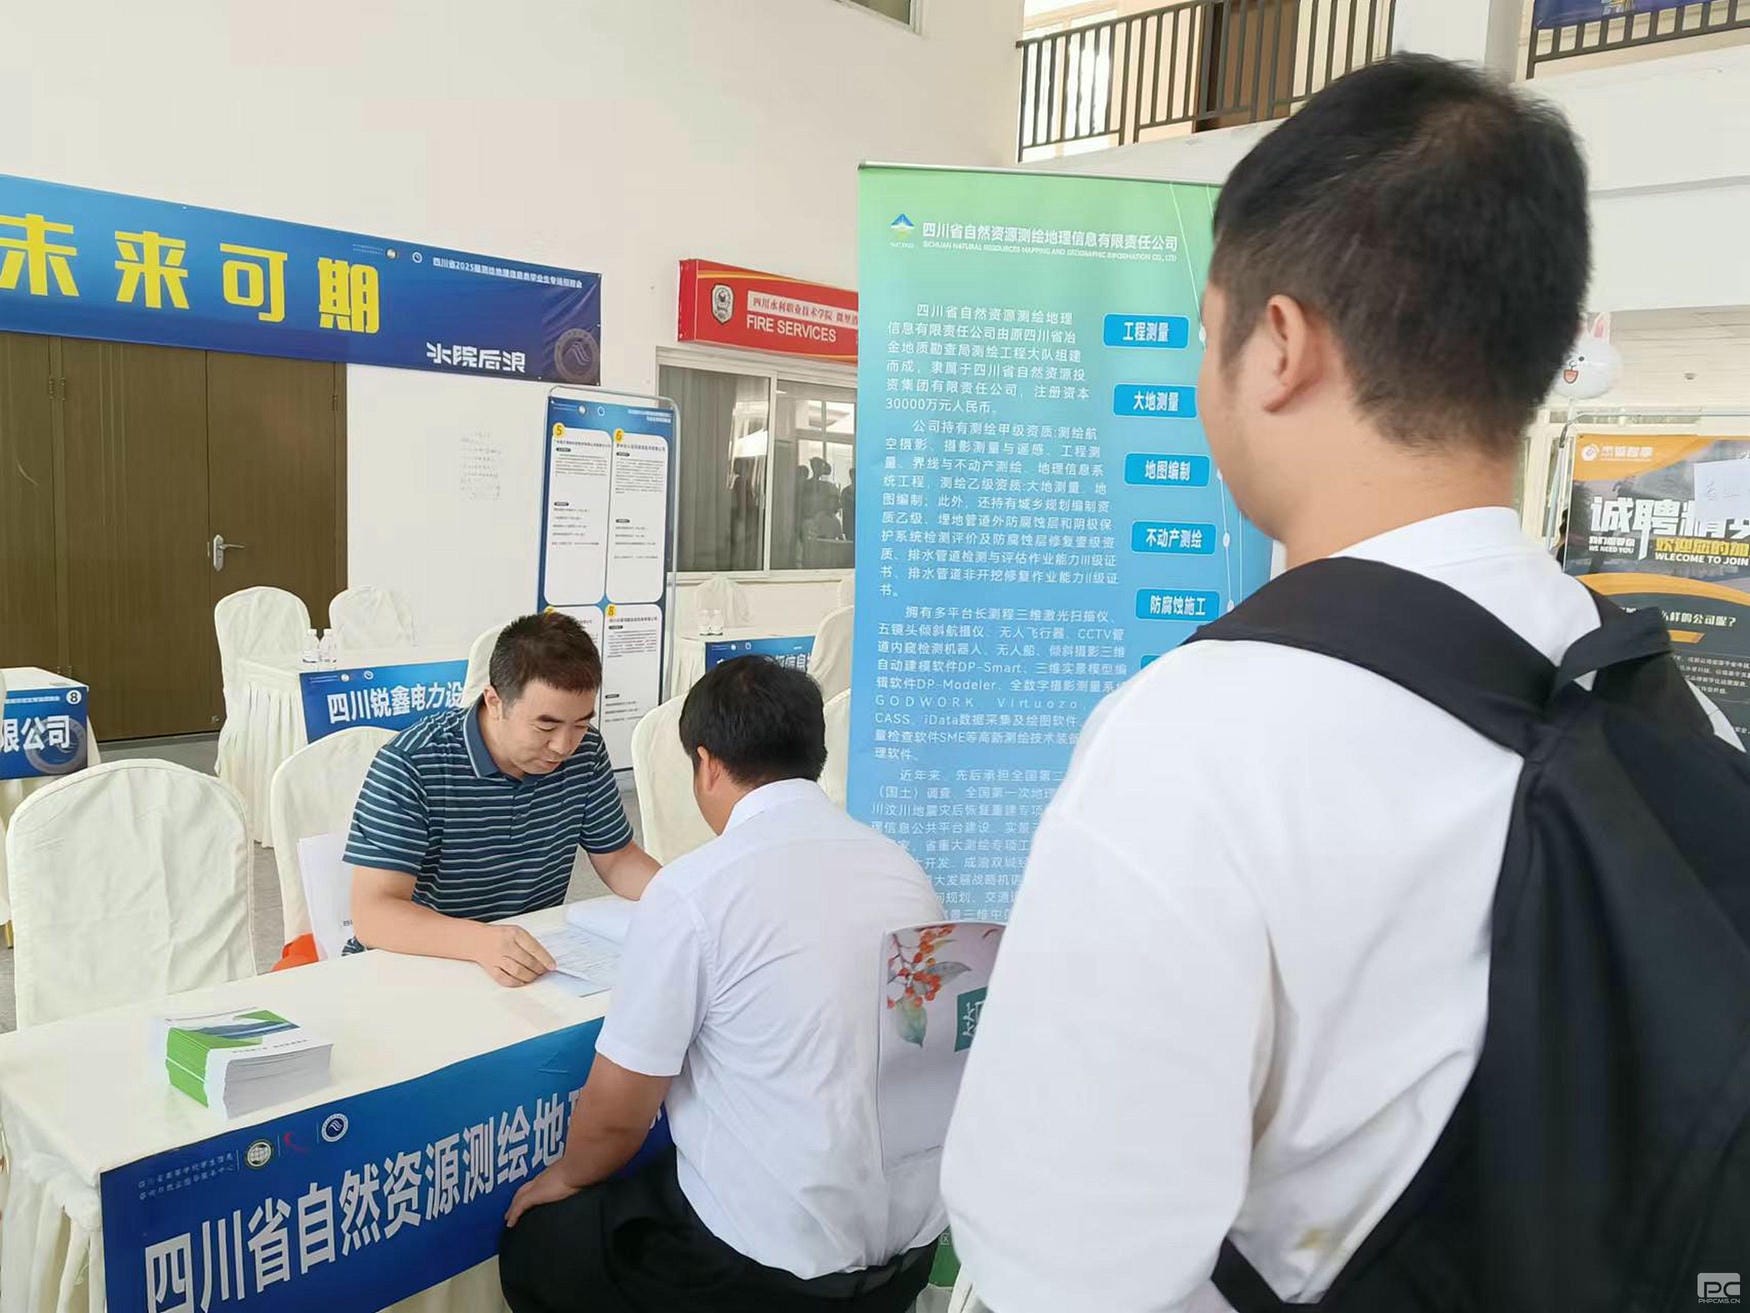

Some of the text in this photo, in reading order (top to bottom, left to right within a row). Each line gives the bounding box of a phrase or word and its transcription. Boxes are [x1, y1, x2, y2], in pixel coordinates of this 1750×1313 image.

[922, 221, 1178, 252] 四川省自然资源测绘地理信息有限责任公司
[0, 212, 380, 335] 未来可期
[917, 303, 1073, 326] 四川省自然资源测绘地理
[746, 314, 837, 343] FIRE SERVICES
[887, 320, 1077, 344] 信息有限责任公司由原四川省冶
[1122, 321, 1170, 344] 工程测量
[887, 341, 1082, 363] 金地质勘查局测绘工程大队组建
[1132, 390, 1180, 412] 大地测量
[1144, 459, 1192, 482] 地图编制
[1145, 528, 1203, 550] 不动产测绘
[1654, 551, 1749, 566] WLECOME TO JOIN
[1149, 594, 1207, 616] 防腐蚀施工
[69, 691, 79, 704] 8
[326, 681, 465, 725] 四川锐鑫电力设
[874, 694, 975, 708] GODWORK
[145, 1088, 583, 1313] 四川省自然资源测绘地
